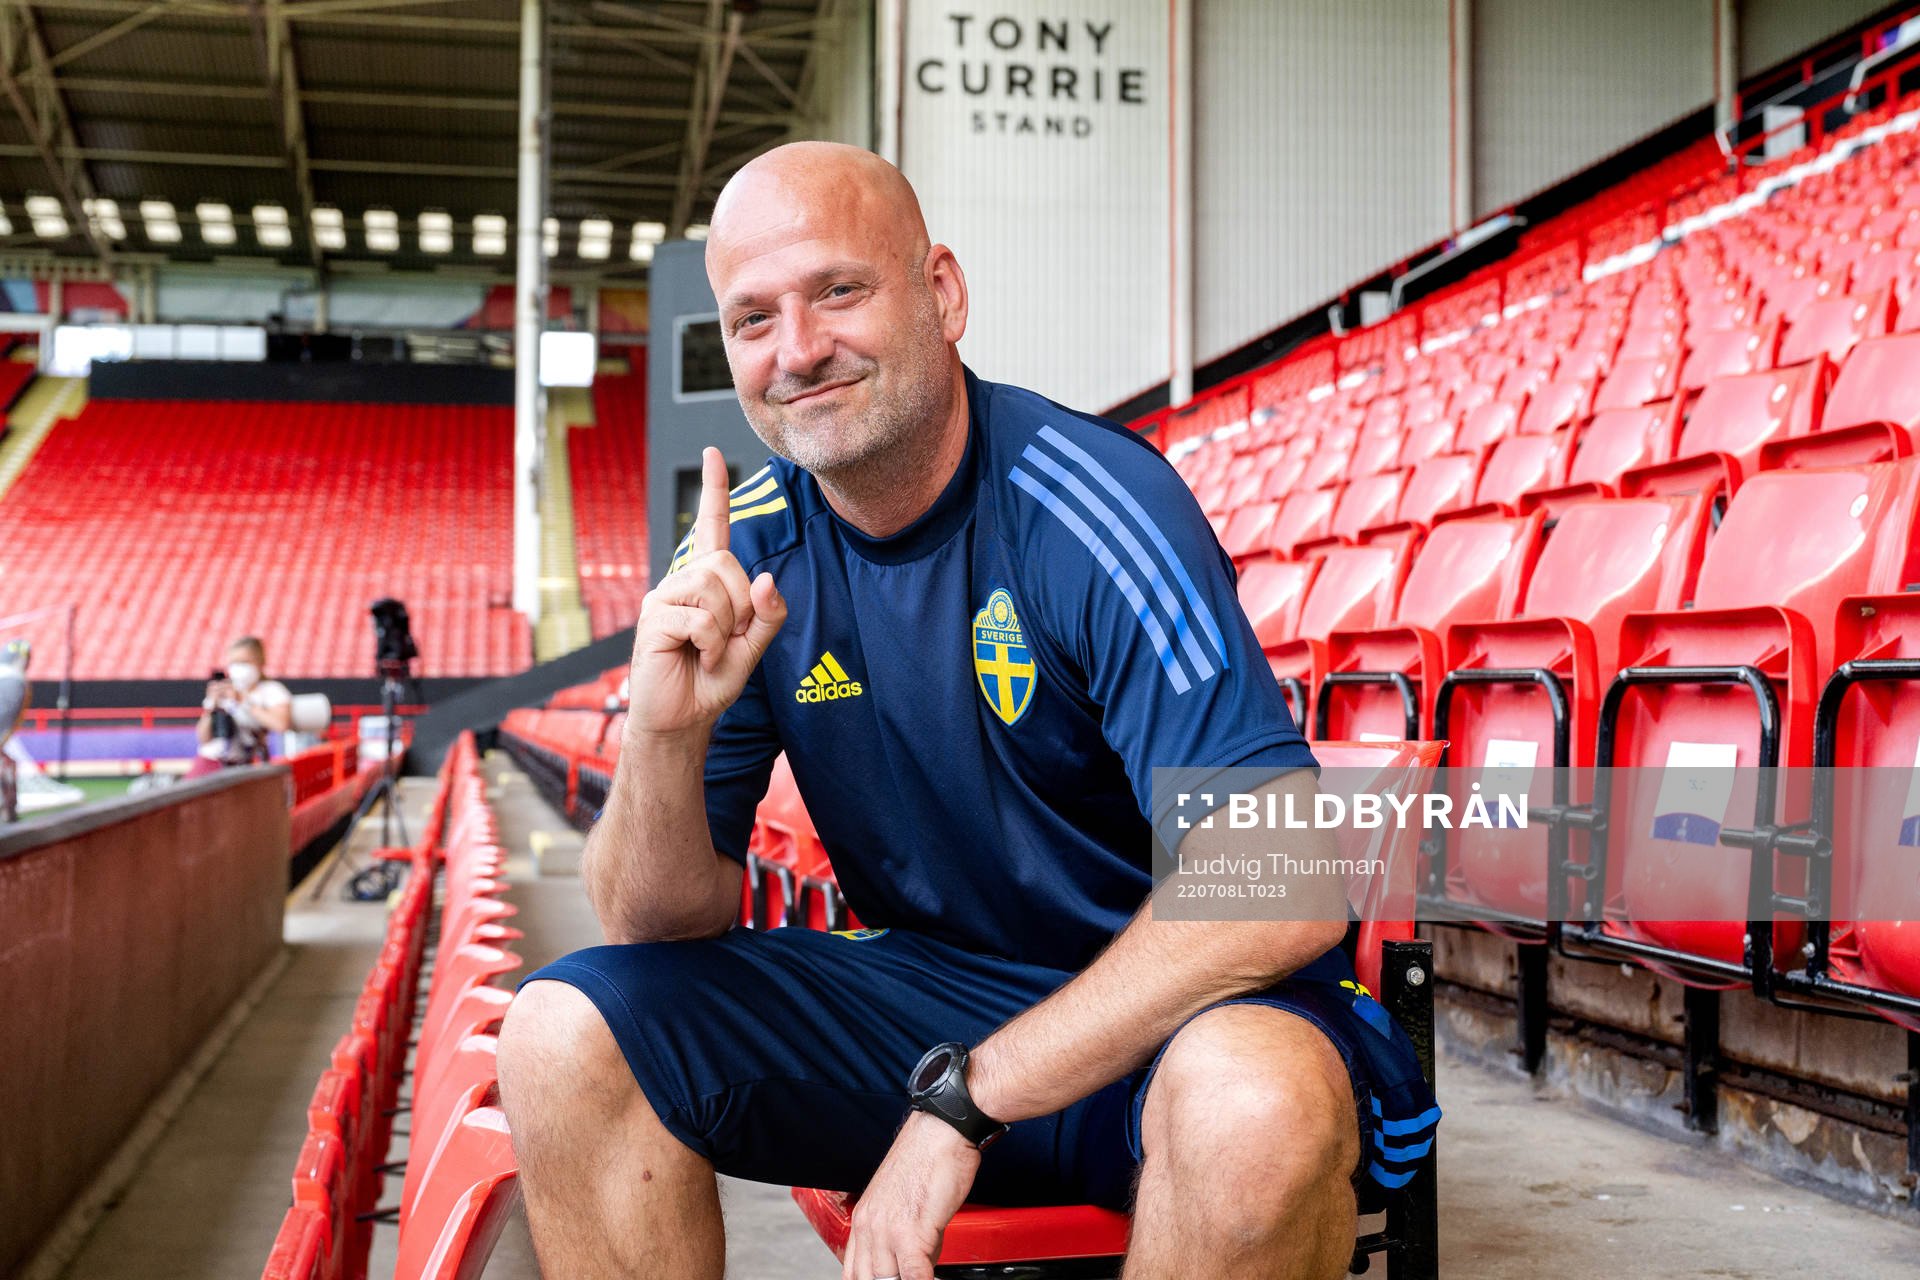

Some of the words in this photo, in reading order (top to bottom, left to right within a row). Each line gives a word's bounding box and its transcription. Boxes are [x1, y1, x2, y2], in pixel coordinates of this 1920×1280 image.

[949, 14, 1112, 54] TONY
[917, 60, 1145, 104] CURRIE
[972, 110, 1092, 137] STAND
[981, 630, 1023, 643] SVERIGE
[795, 681, 863, 703] adidas
